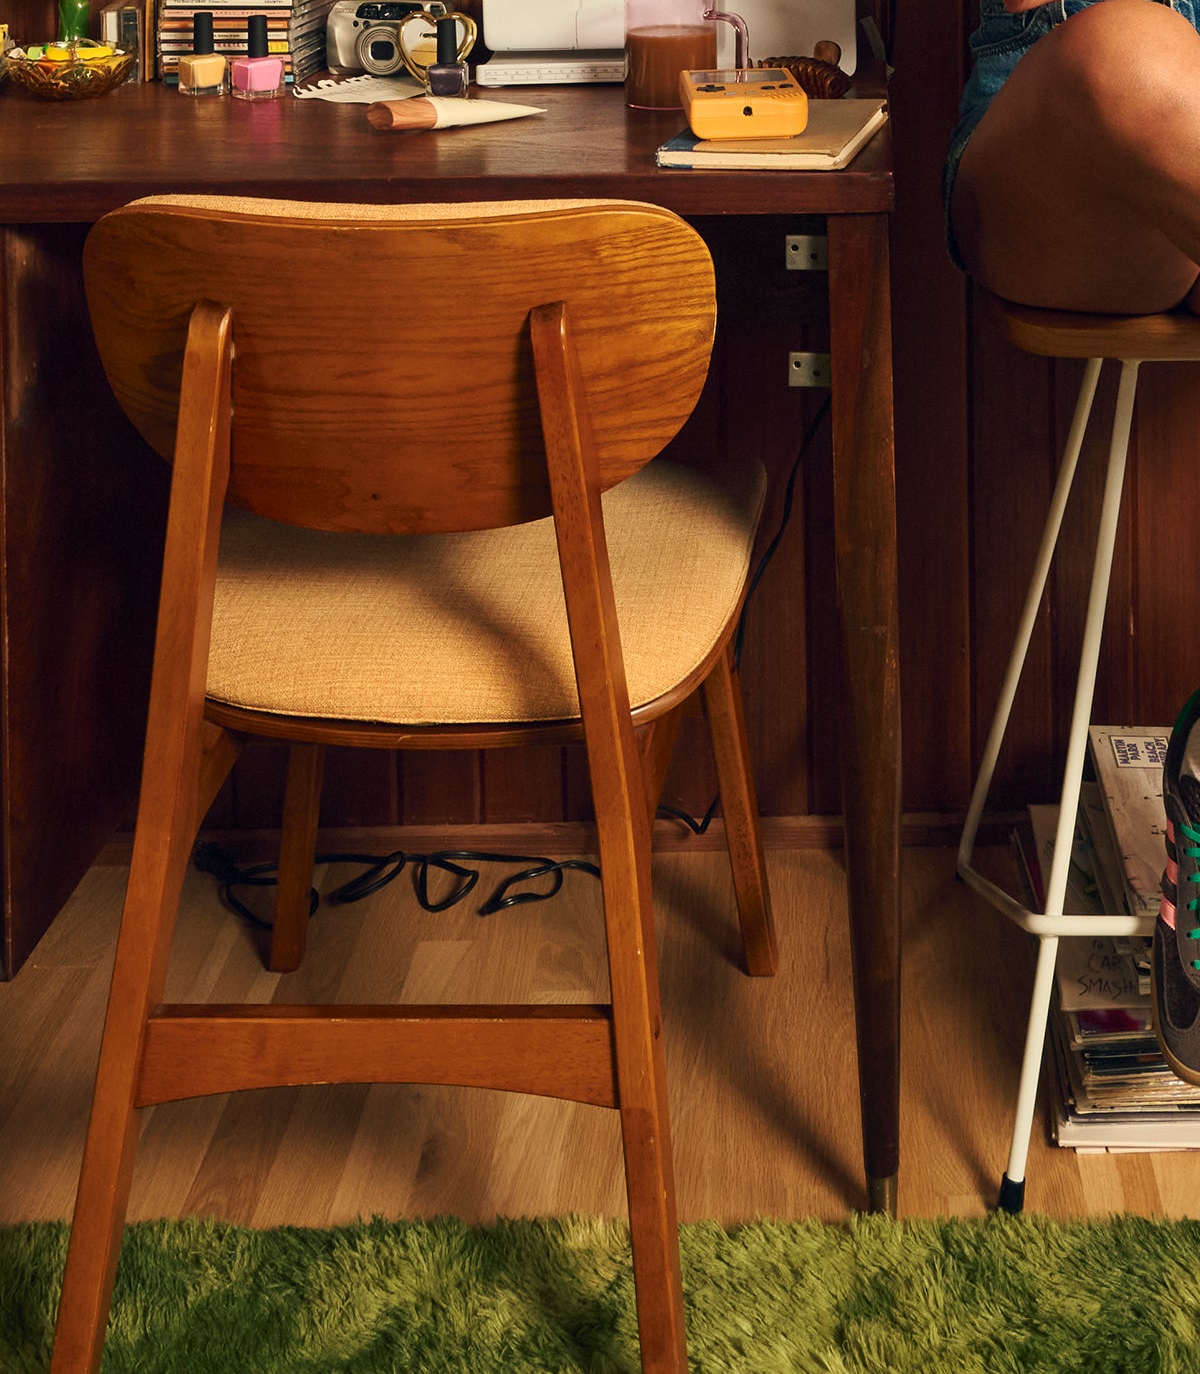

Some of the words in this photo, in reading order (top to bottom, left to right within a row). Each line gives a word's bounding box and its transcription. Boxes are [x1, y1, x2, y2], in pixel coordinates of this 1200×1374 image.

[1113, 738, 1131, 765] MARTIN
[1126, 743, 1142, 761] PARR
[1143, 741, 1161, 763] BEACH
